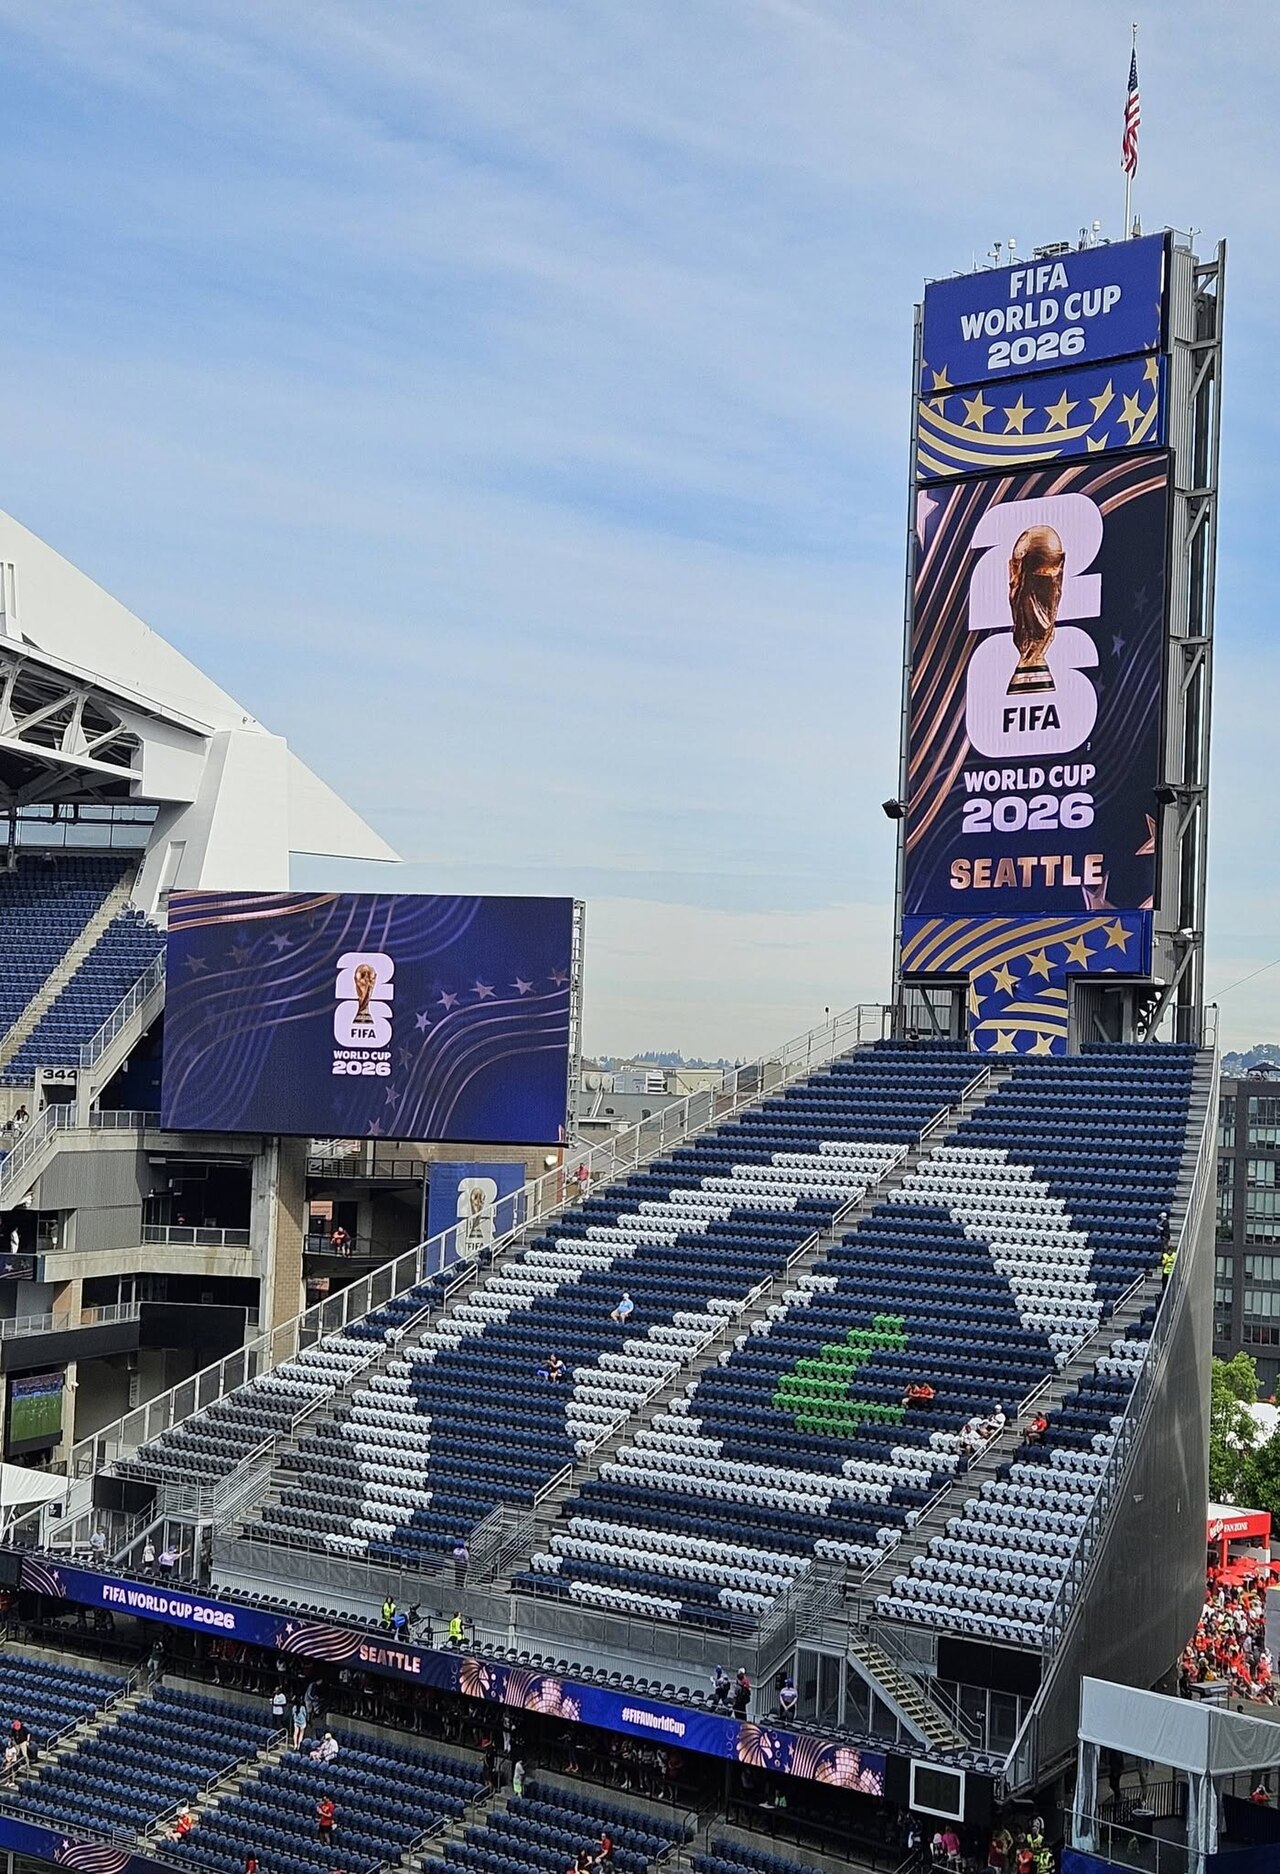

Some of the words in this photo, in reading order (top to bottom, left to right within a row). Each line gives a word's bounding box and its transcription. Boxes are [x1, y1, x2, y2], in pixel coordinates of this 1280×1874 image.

[1010, 262, 1069, 298] FIFA
[960, 298, 1059, 341] WORLD
[1064, 285, 1122, 321] CUP
[987, 327, 1085, 369] 2026
[1003, 704, 1061, 733] FIFA
[964, 767, 1045, 793] WORLD
[1049, 764, 1096, 788] CUP
[962, 792, 1095, 834] 2026
[950, 854, 1104, 890] SEATTLE
[351, 1028, 376, 1039] FIFA
[332, 1060, 391, 1076] 2026
[333, 1050, 370, 1060] WORLD
[370, 1051, 392, 1061] CUP
[43, 1069, 77, 1079] 344
[103, 1585, 126, 1604] FIFA
[127, 1590, 168, 1613] WORLD
[168, 1600, 193, 1619] CUP
[193, 1606, 236, 1629] 2026
[359, 1644, 421, 1674] SEATTLE
[621, 1706, 686, 1738] #FIFAWorldCup
